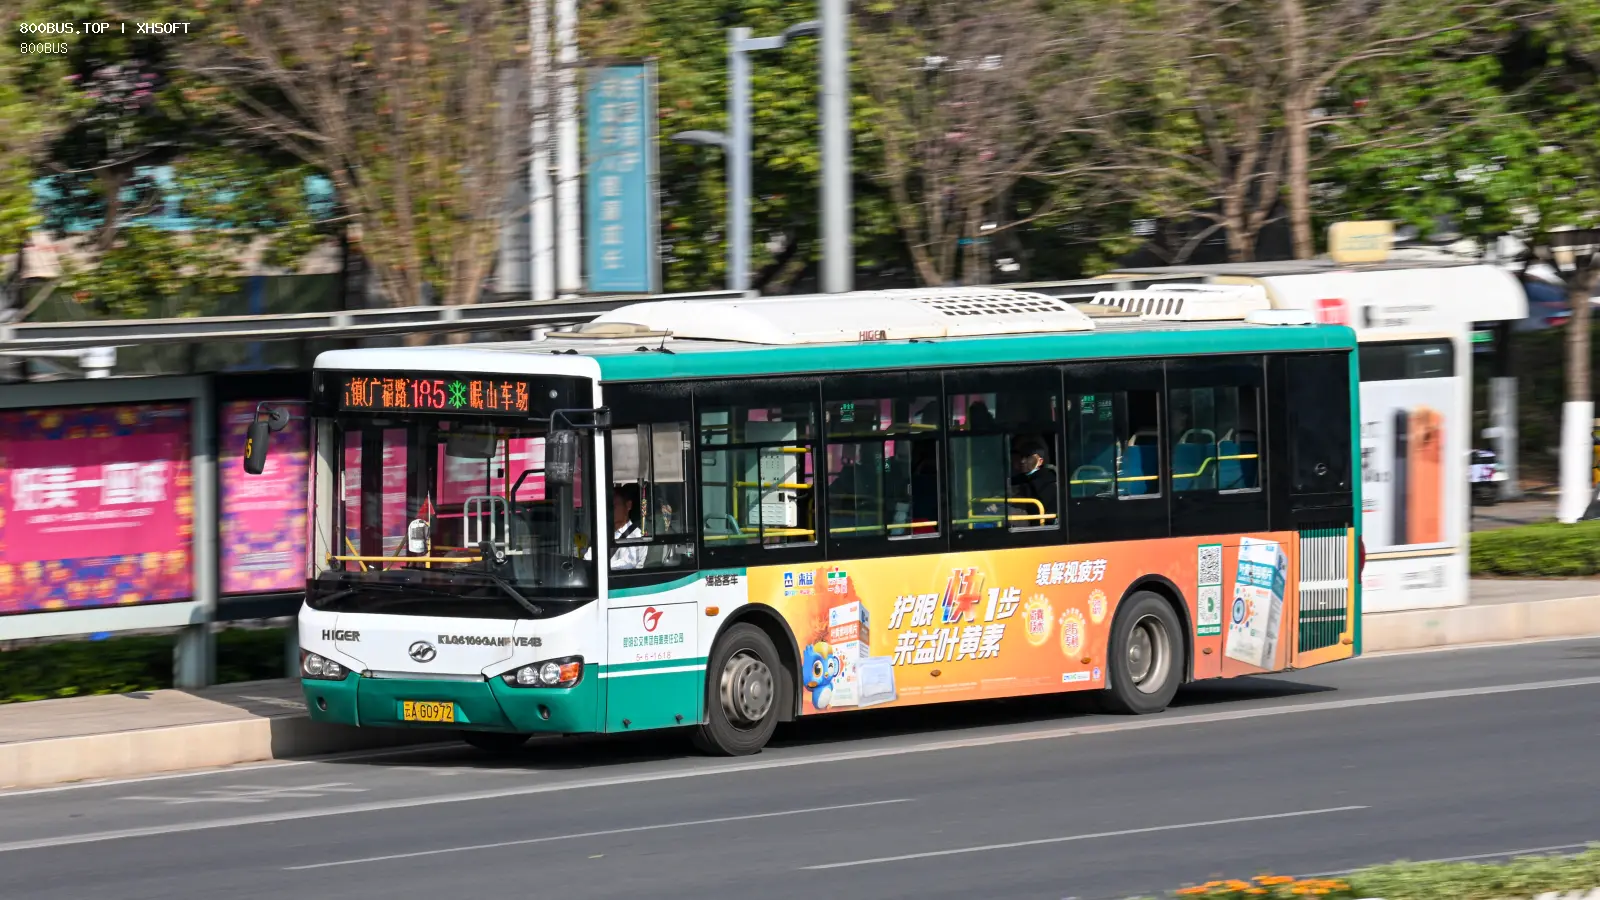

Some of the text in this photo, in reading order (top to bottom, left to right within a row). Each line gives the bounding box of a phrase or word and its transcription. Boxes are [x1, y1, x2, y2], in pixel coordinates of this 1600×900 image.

[858, 329, 887, 341] HIGER
[411, 378, 446, 409] 185
[1036, 559, 1107, 586] 缓解视疲劳
[888, 567, 1022, 630] 护眼快1步
[322, 629, 360, 642] HIGER
[892, 624, 1005, 666] 来益叶黄素
